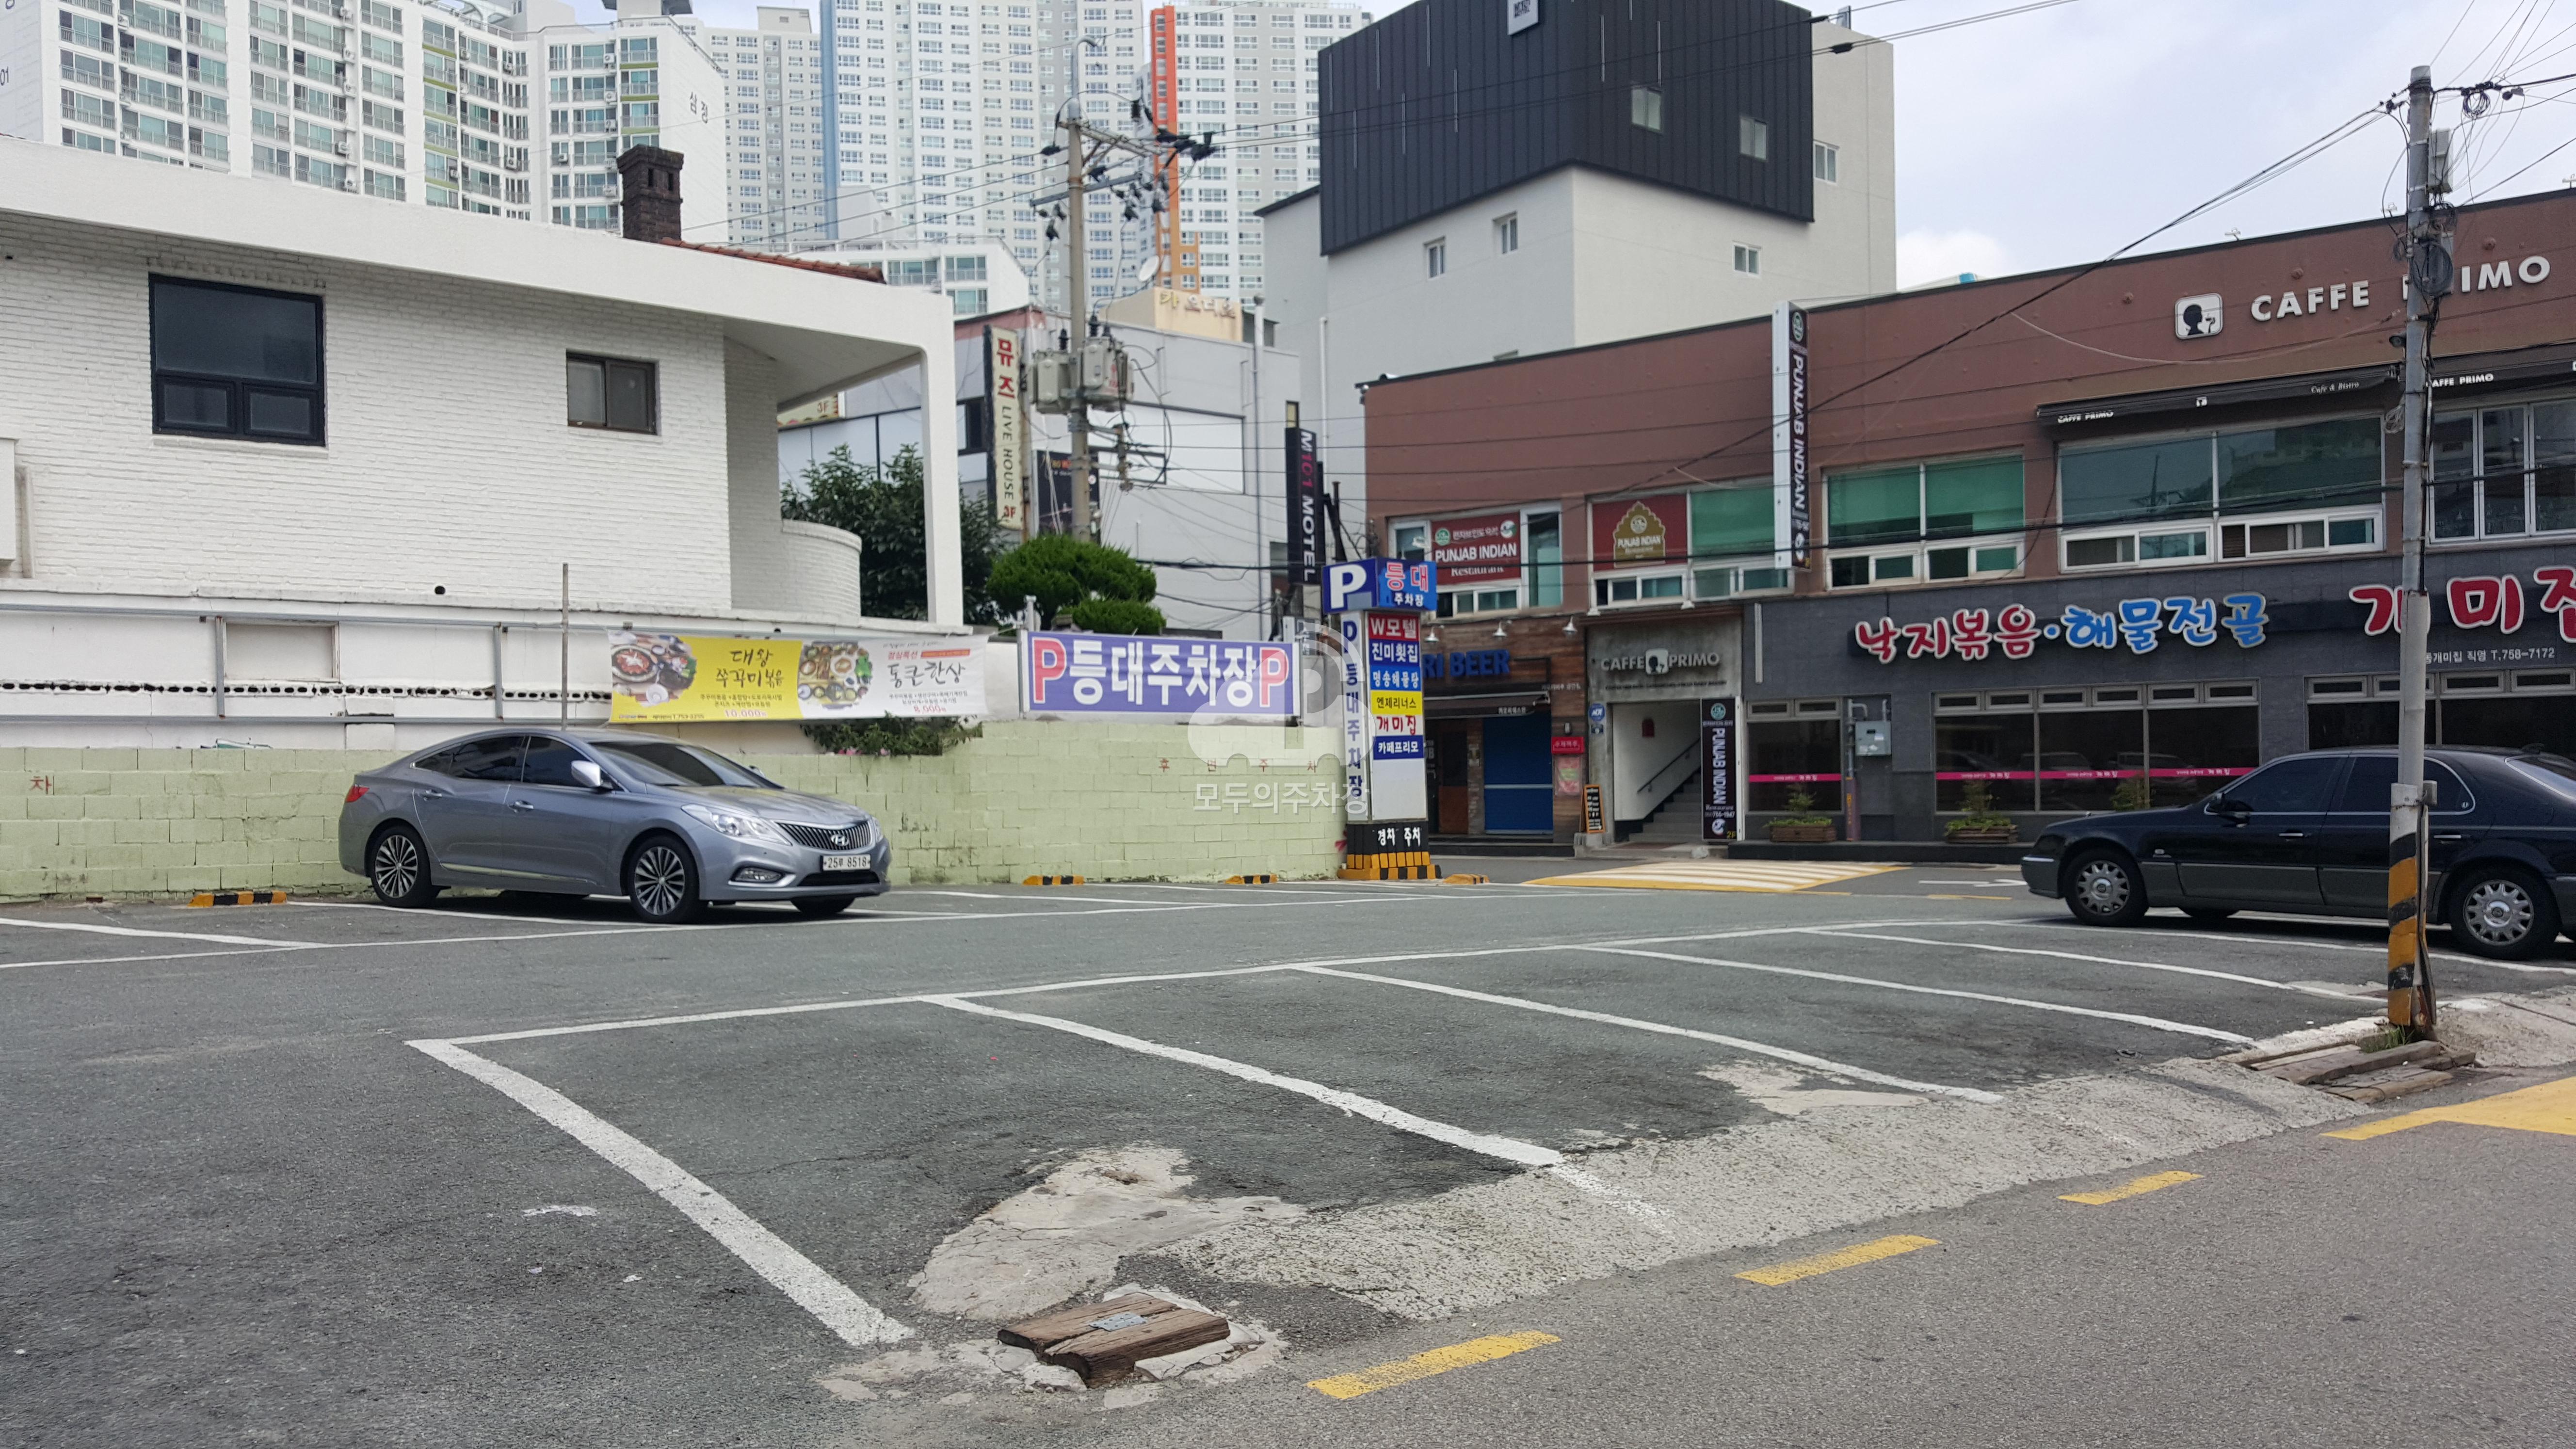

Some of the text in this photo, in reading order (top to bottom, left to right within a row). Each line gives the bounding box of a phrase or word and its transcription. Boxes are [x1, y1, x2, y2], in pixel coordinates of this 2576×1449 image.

[2251, 279, 2369, 322] CAFFE
[2426, 373, 2494, 387] AFFE PRIMO
[1793, 354, 1805, 435] PUNJAB
[1002, 406, 1014, 500] LIVE HOUSE
[1794, 439, 1805, 509] INDIAN
[1303, 495, 1316, 581] MOTEL
[1435, 543, 1516, 563] PUNJAB INDIAN
[1330, 564, 1367, 609] P
[1385, 562, 1429, 592] 등대
[1394, 593, 1424, 607] 주차장
[730, 649, 773, 667] 대왕
[1371, 642, 1419, 663] 진미횟집
[1450, 648, 1510, 677] BEER
[1669, 652, 1720, 667] PRIMO
[1601, 656, 1645, 671] CAFFE
[1376, 697, 1417, 709] 엔제리너스
[1376, 715, 1417, 735] 개미집
[1378, 741, 1419, 754] 카페프리모
[1712, 727, 1725, 768] PUNJAB
[1713, 770, 1726, 805] INDIAN
[847, 856, 867, 868] 8518
